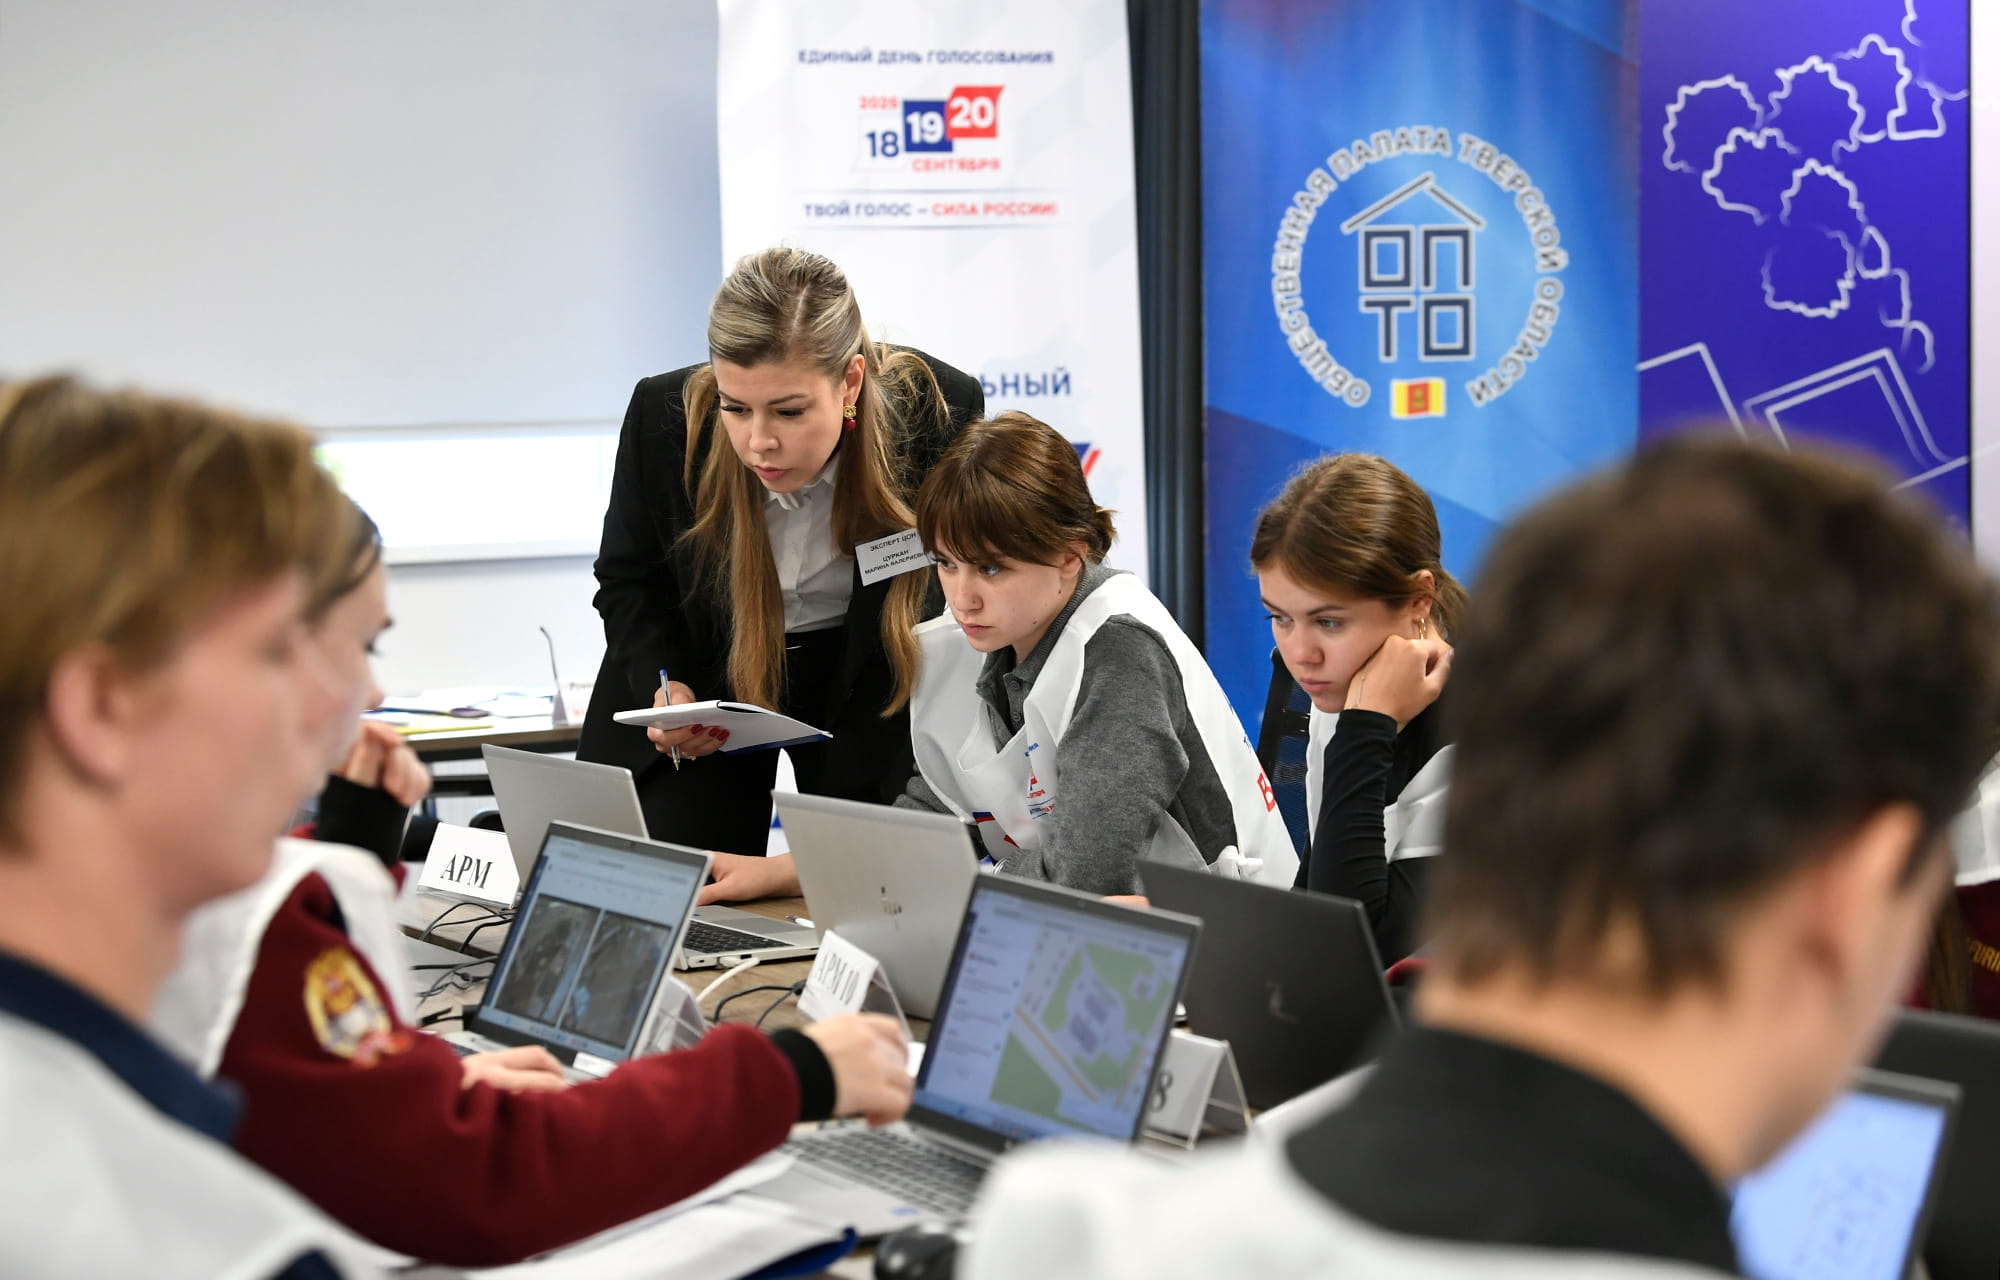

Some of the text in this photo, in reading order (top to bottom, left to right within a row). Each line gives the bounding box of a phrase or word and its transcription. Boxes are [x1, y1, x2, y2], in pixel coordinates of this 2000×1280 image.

[799, 46, 1054, 64] ЕДИНЫЙ ДЕНЬ ГОЛОСОВАНИЯ
[866, 97, 995, 158] 18 19 20
[912, 158, 1001, 172] СЕНТЯБРЯ
[804, 199, 850, 217] ТВОЙ
[855, 203, 912, 217] ГОЛОС
[932, 203, 978, 216] СИЛА
[1272, 126, 1568, 406] ОБЩЕСТВЕННАЯ ПАЛАТА ТВЕРСКОЙ ОБЛАСТИ
[1361, 227, 1473, 291] ОП
[1361, 296, 1473, 359] ТО
[870, 532, 916, 551] ЭКСПЕРТ ЦОН
[865, 563, 889, 574] МАРИНА
[882, 549, 909, 562] ЦУРКАН
[440, 853, 494, 889] АРМ
[814, 951, 848, 995] АРМ
